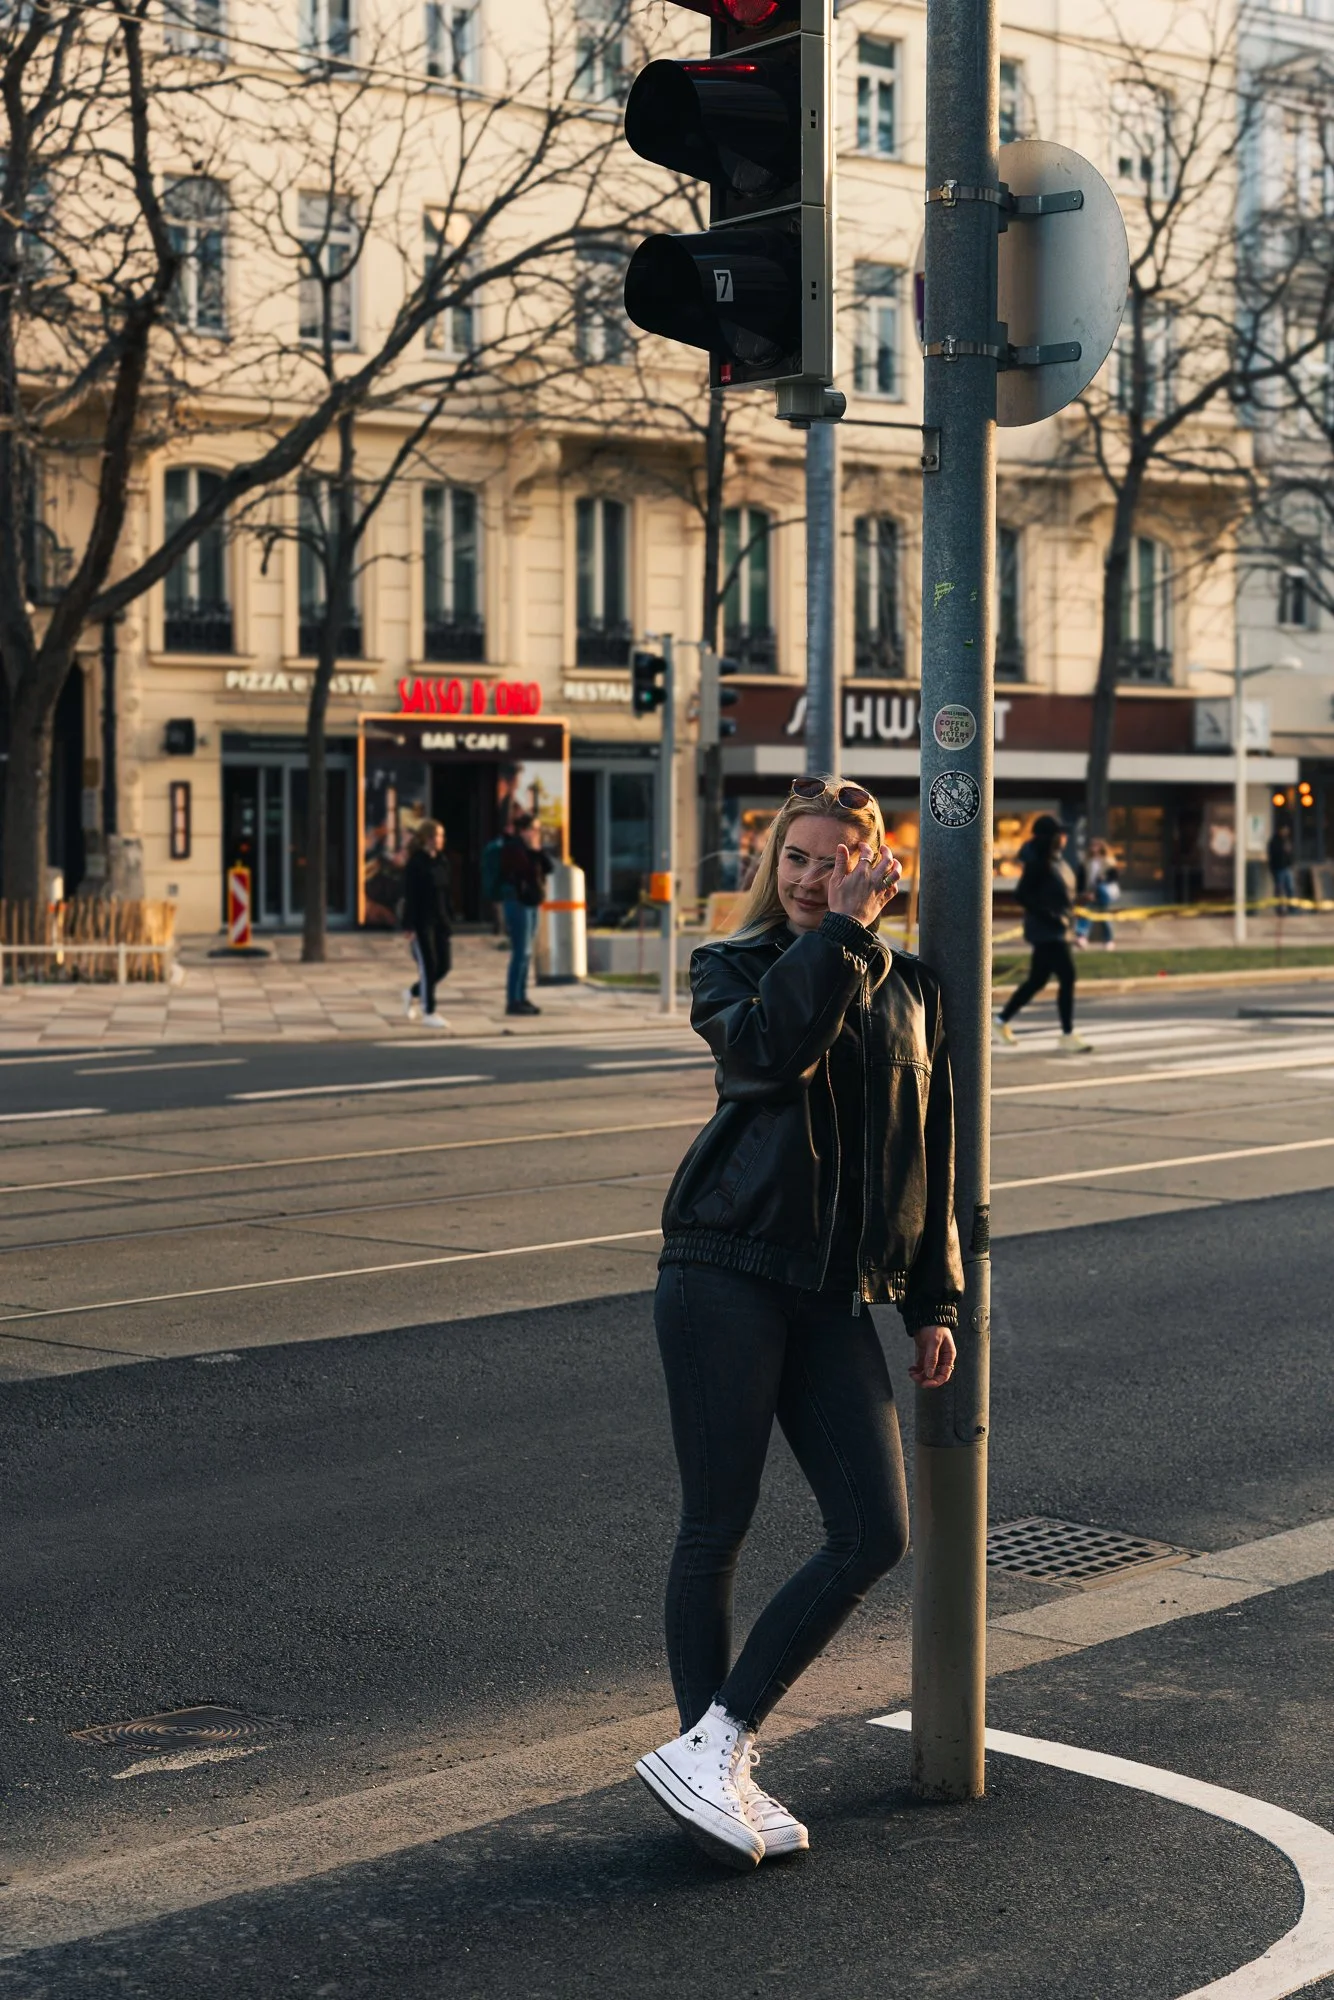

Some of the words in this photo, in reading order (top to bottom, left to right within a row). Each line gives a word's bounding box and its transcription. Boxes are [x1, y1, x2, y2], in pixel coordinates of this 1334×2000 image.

[716, 273, 729, 299] 7
[226, 670, 288, 692] PIZZA
[398, 677, 464, 714] SASSO
[939, 719, 970, 728] COFFEE
[421, 732, 455, 750] BAR
[940, 730, 970, 739] METERS
[941, 736, 966, 744] AWAY
[939, 814, 971, 826] VIENNA
